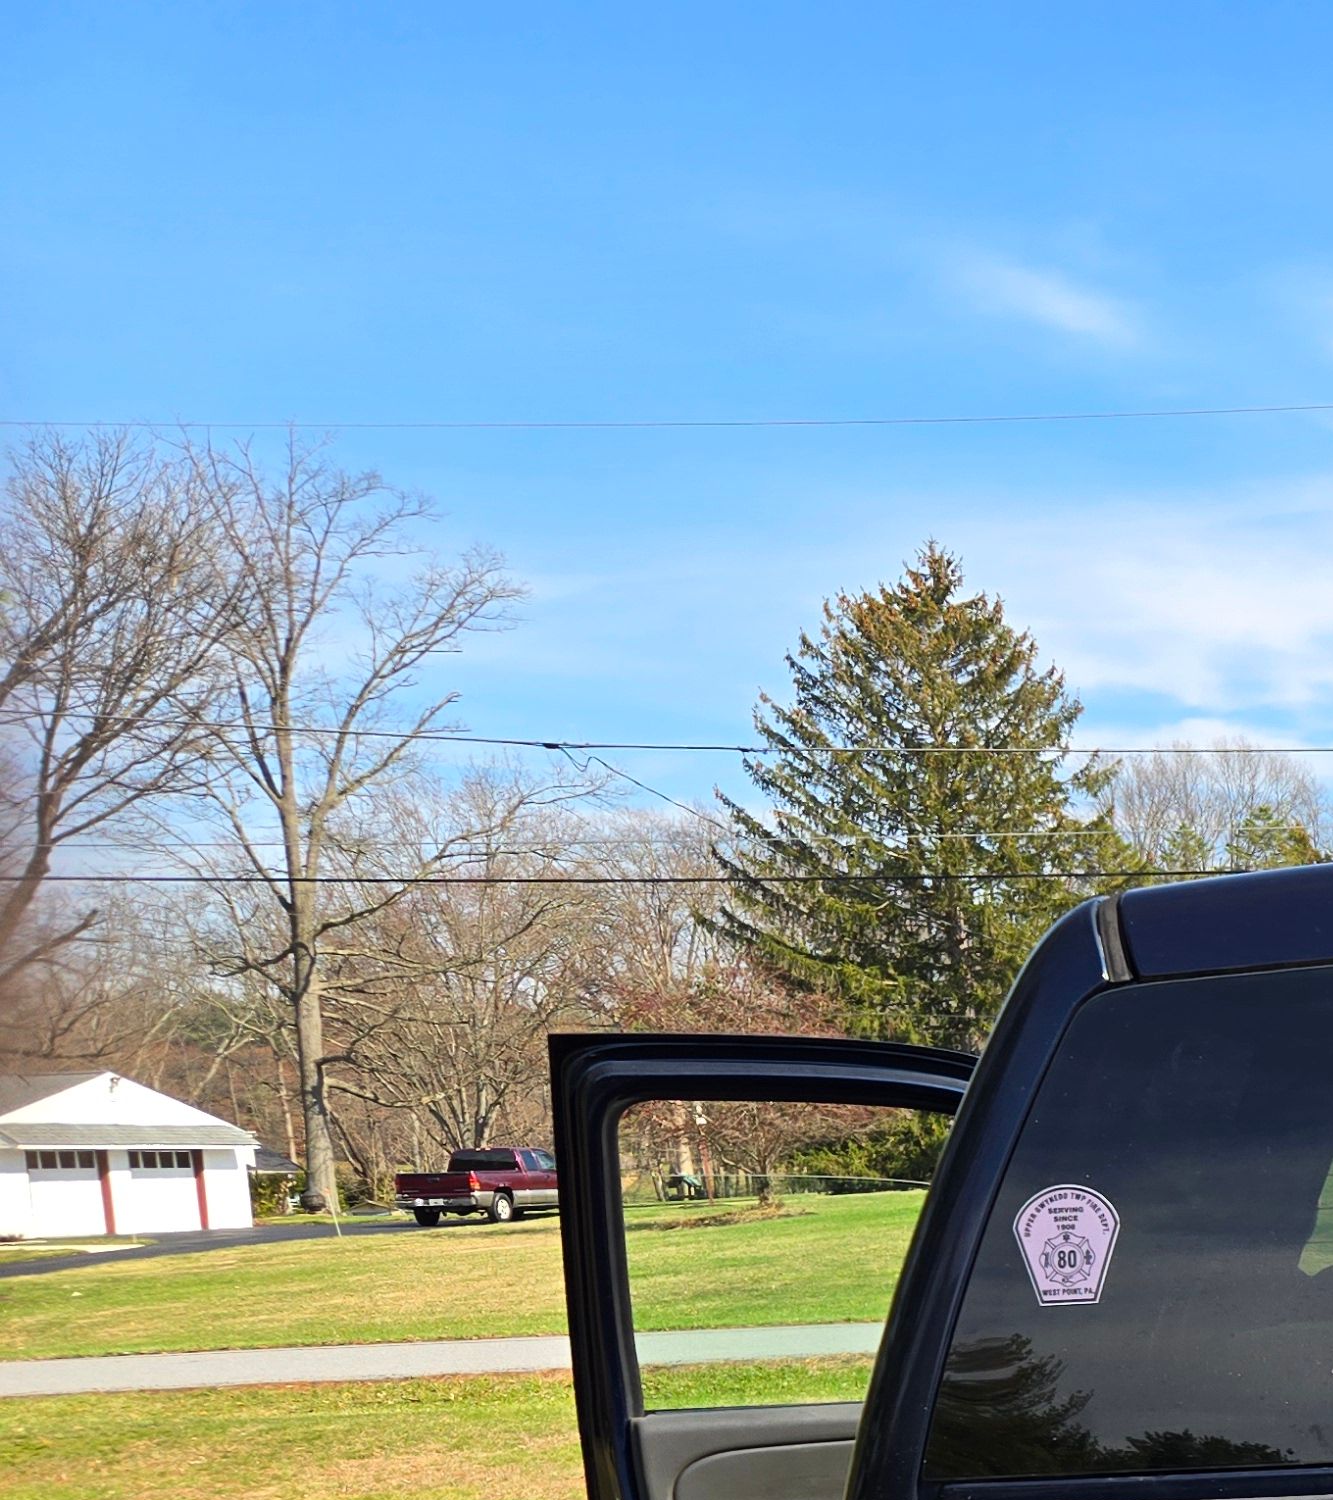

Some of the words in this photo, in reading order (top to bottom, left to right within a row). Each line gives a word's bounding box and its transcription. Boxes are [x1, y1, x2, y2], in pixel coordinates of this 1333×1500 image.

[1024, 1213, 1037, 1238] UPPER
[1035, 1193, 1068, 1213] GWYNEDD
[1071, 1192, 1086, 1201] TWP
[1086, 1199, 1101, 1213] FIRE
[1048, 1206, 1084, 1214] SERVING
[1057, 1249, 1077, 1269] 80
